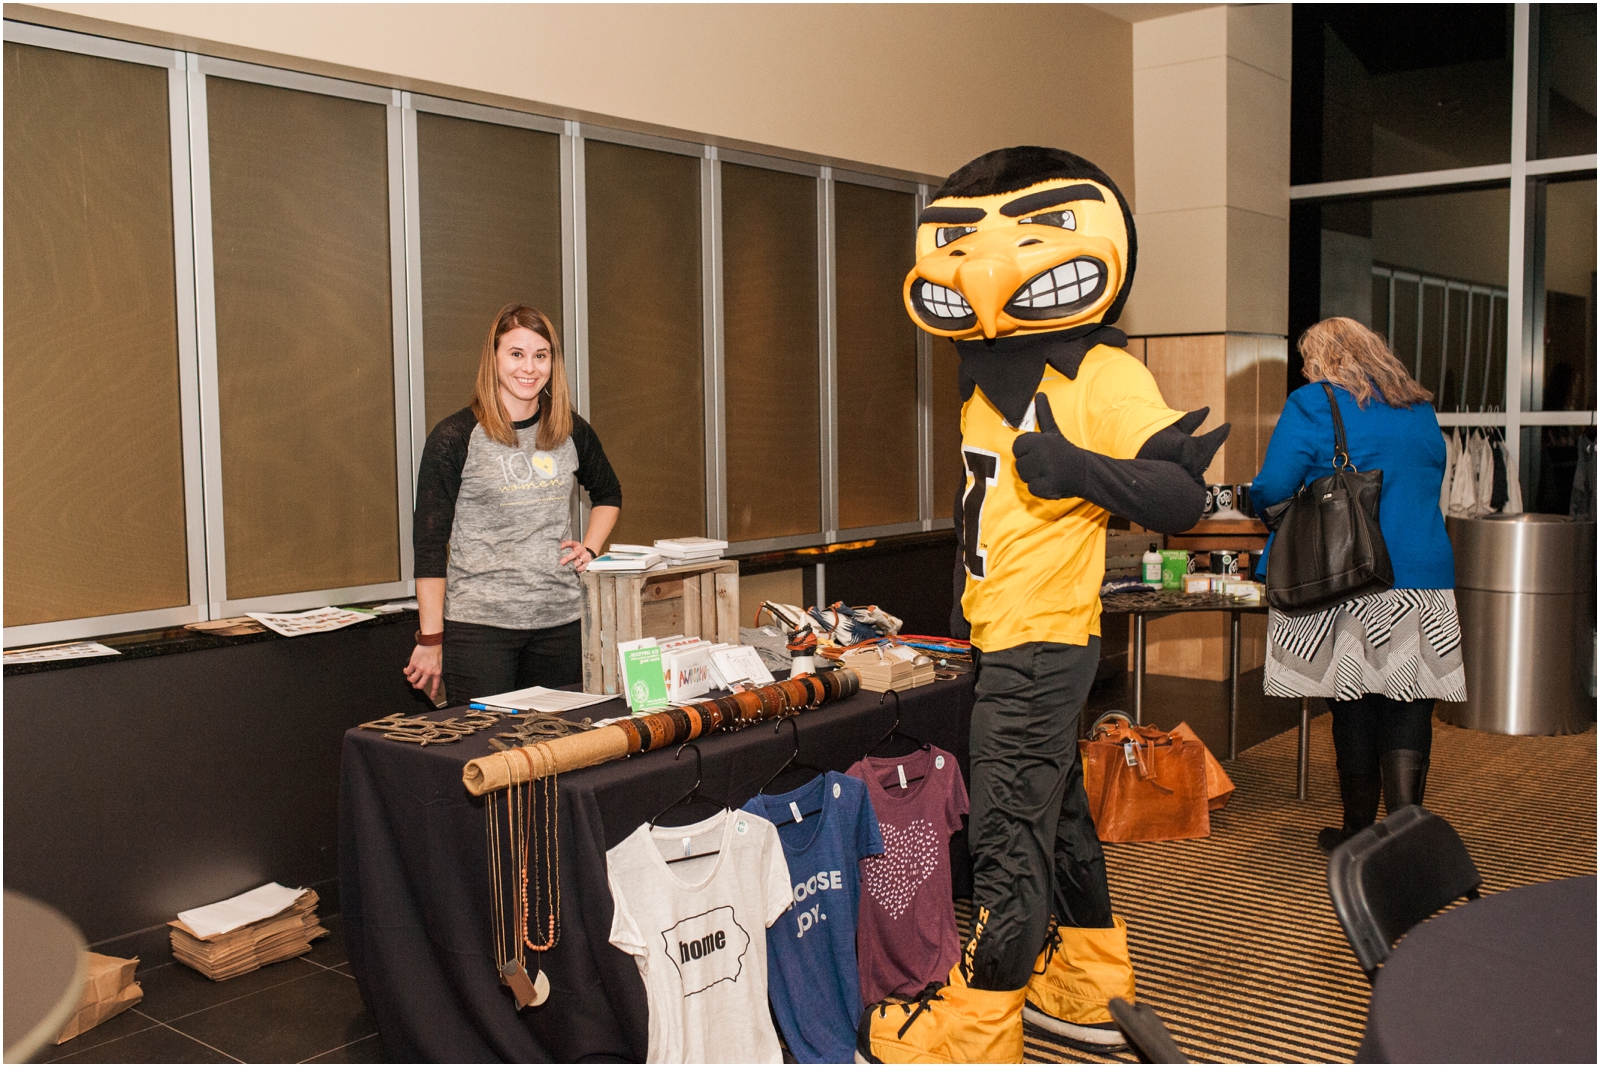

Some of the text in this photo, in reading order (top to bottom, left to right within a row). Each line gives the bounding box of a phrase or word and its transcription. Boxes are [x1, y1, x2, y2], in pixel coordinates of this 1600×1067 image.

[787, 870, 842, 911] OOSE
[796, 903, 827, 938] JOY.
[678, 929, 726, 965] home
[964, 905, 991, 984] HERKY
